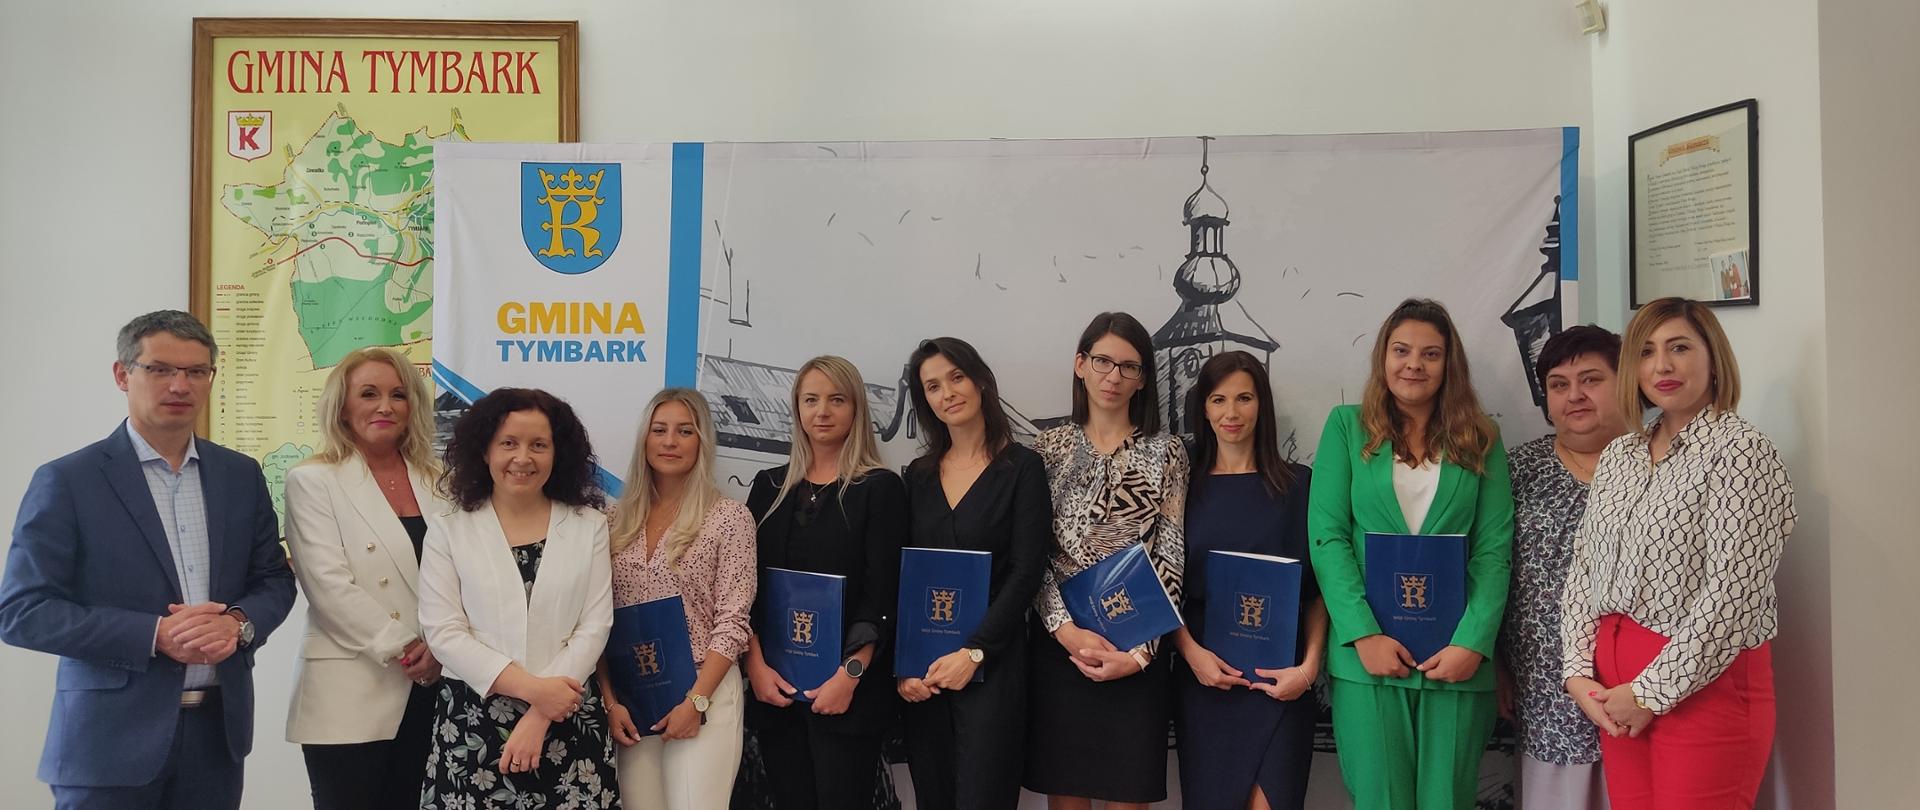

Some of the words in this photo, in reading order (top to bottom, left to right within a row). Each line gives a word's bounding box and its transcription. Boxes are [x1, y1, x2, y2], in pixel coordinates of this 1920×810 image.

[227, 50, 350, 94] GMINA
[362, 50, 541, 95] TYMBARK
[496, 301, 646, 335] GMINA
[495, 340, 648, 363] TYMBARK
